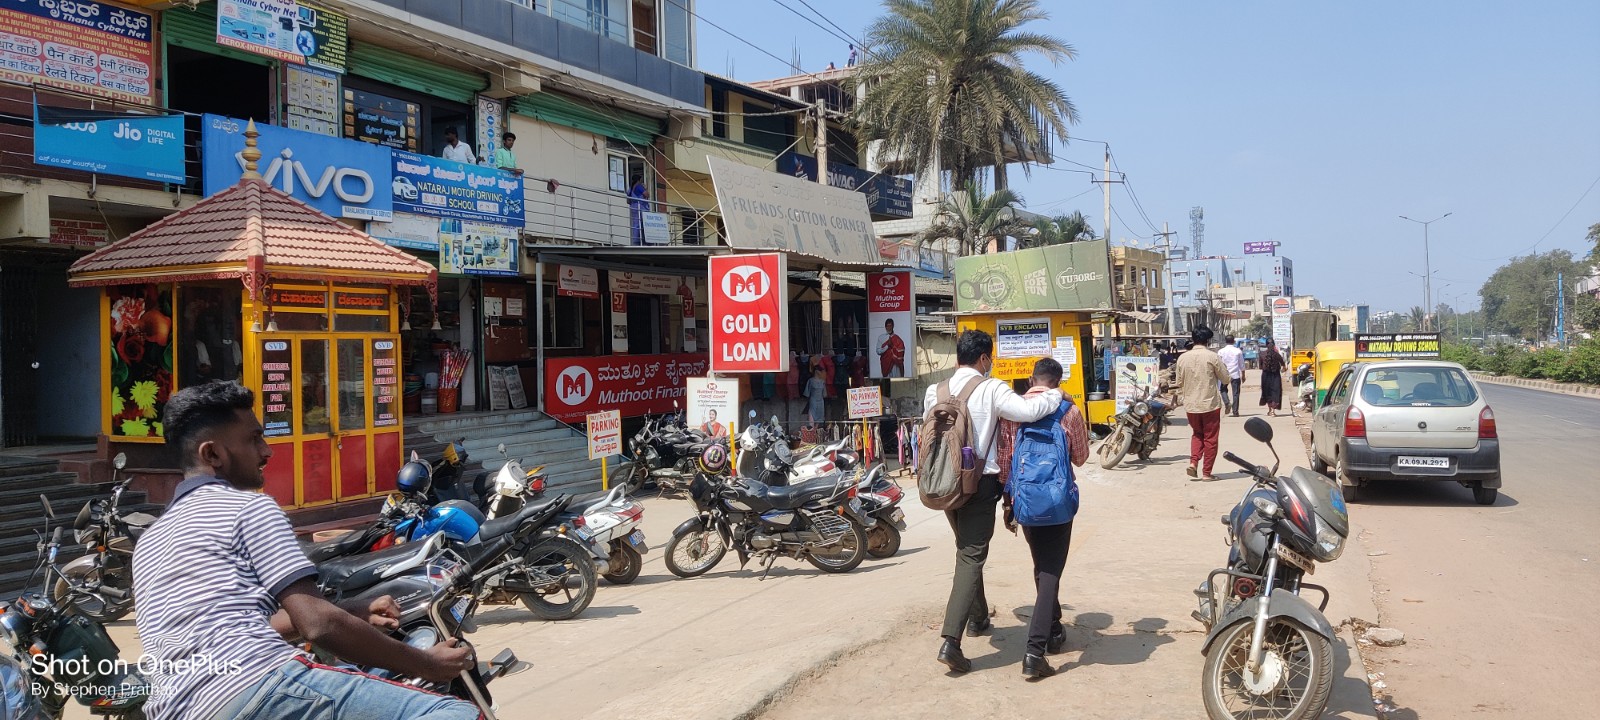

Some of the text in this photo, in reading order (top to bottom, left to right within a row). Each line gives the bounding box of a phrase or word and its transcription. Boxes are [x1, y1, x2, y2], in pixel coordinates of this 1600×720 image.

[260, 2, 281, 14] Cyber
[283, 8, 297, 18] Net
[63, 12, 146, 39] Thanu Cyber Net
[47, 47, 94, 66] पैन कार्ड
[100, 58, 116, 70] मनी
[70, 70, 96, 85] टिकट
[114, 122, 142, 141] Jio
[148, 128, 176, 140] DIGITAL
[148, 136, 164, 145] LIFE
[417, 181, 503, 203] NATARAJ MOTOR DRIVING
[448, 199, 476, 211] SCHOOL
[732, 196, 867, 233] FRIENDS COTTON CORNER
[1024, 268, 1046, 280] OPEN
[1060, 272, 1096, 286] TUBORG
[1024, 276, 1048, 288] FOR
[614, 293, 624, 304] 57
[1024, 286, 1048, 298] FUN
[684, 300, 692, 310] 57
[722, 314, 772, 334] GOLD
[268, 342, 284, 350] SVB
[722, 342, 772, 362] LOAN
[1368, 342, 1393, 354] NATARAJ
[1394, 342, 1416, 353] DRIVING
[1417, 341, 1439, 352] SCHOOL
[598, 360, 660, 386] ಮುತ್ತೂಟ್
[598, 385, 688, 405] Muthoot Finan
[859, 392, 878, 400] PARKING
[267, 404, 286, 412] RENT
[592, 418, 619, 434] PARKING
